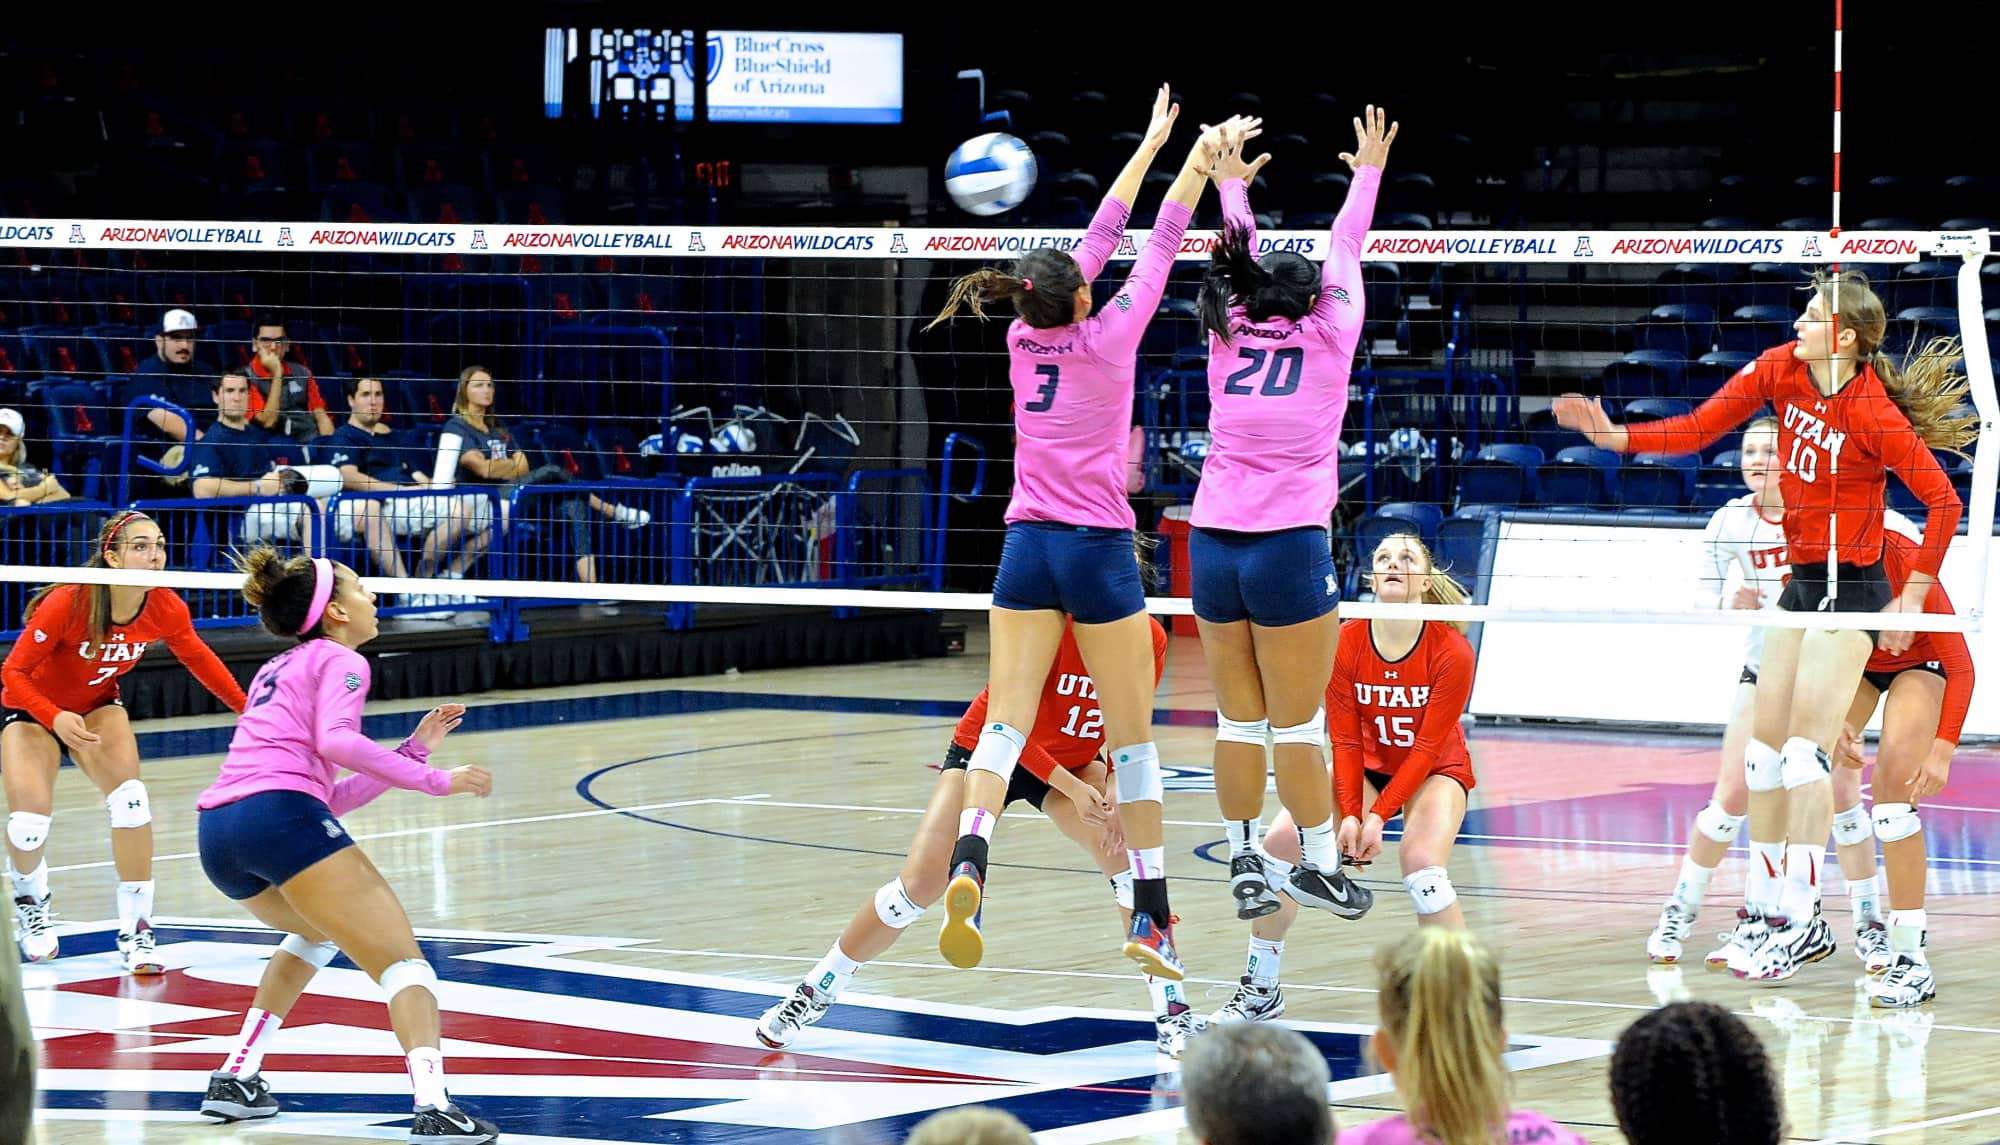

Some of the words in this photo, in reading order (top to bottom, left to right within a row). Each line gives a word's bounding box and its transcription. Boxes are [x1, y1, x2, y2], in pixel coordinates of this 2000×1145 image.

[734, 37, 825, 53] BlueCross
[734, 57, 831, 74] BlueShield
[733, 78, 753, 94] of
[759, 79, 826, 94] Arizona
[1840, 239, 1918, 255] ARIZON
[1224, 346, 1304, 397] 20
[1025, 363, 1060, 412] 3
[1783, 402, 1847, 454] UTAH
[1785, 437, 1818, 483] 10
[78, 641, 148, 662] UTAH
[87, 666, 119, 686] 7
[1354, 682, 1430, 708] UTAH
[1060, 705, 1105, 739] 12
[1374, 715, 1415, 747] 15
